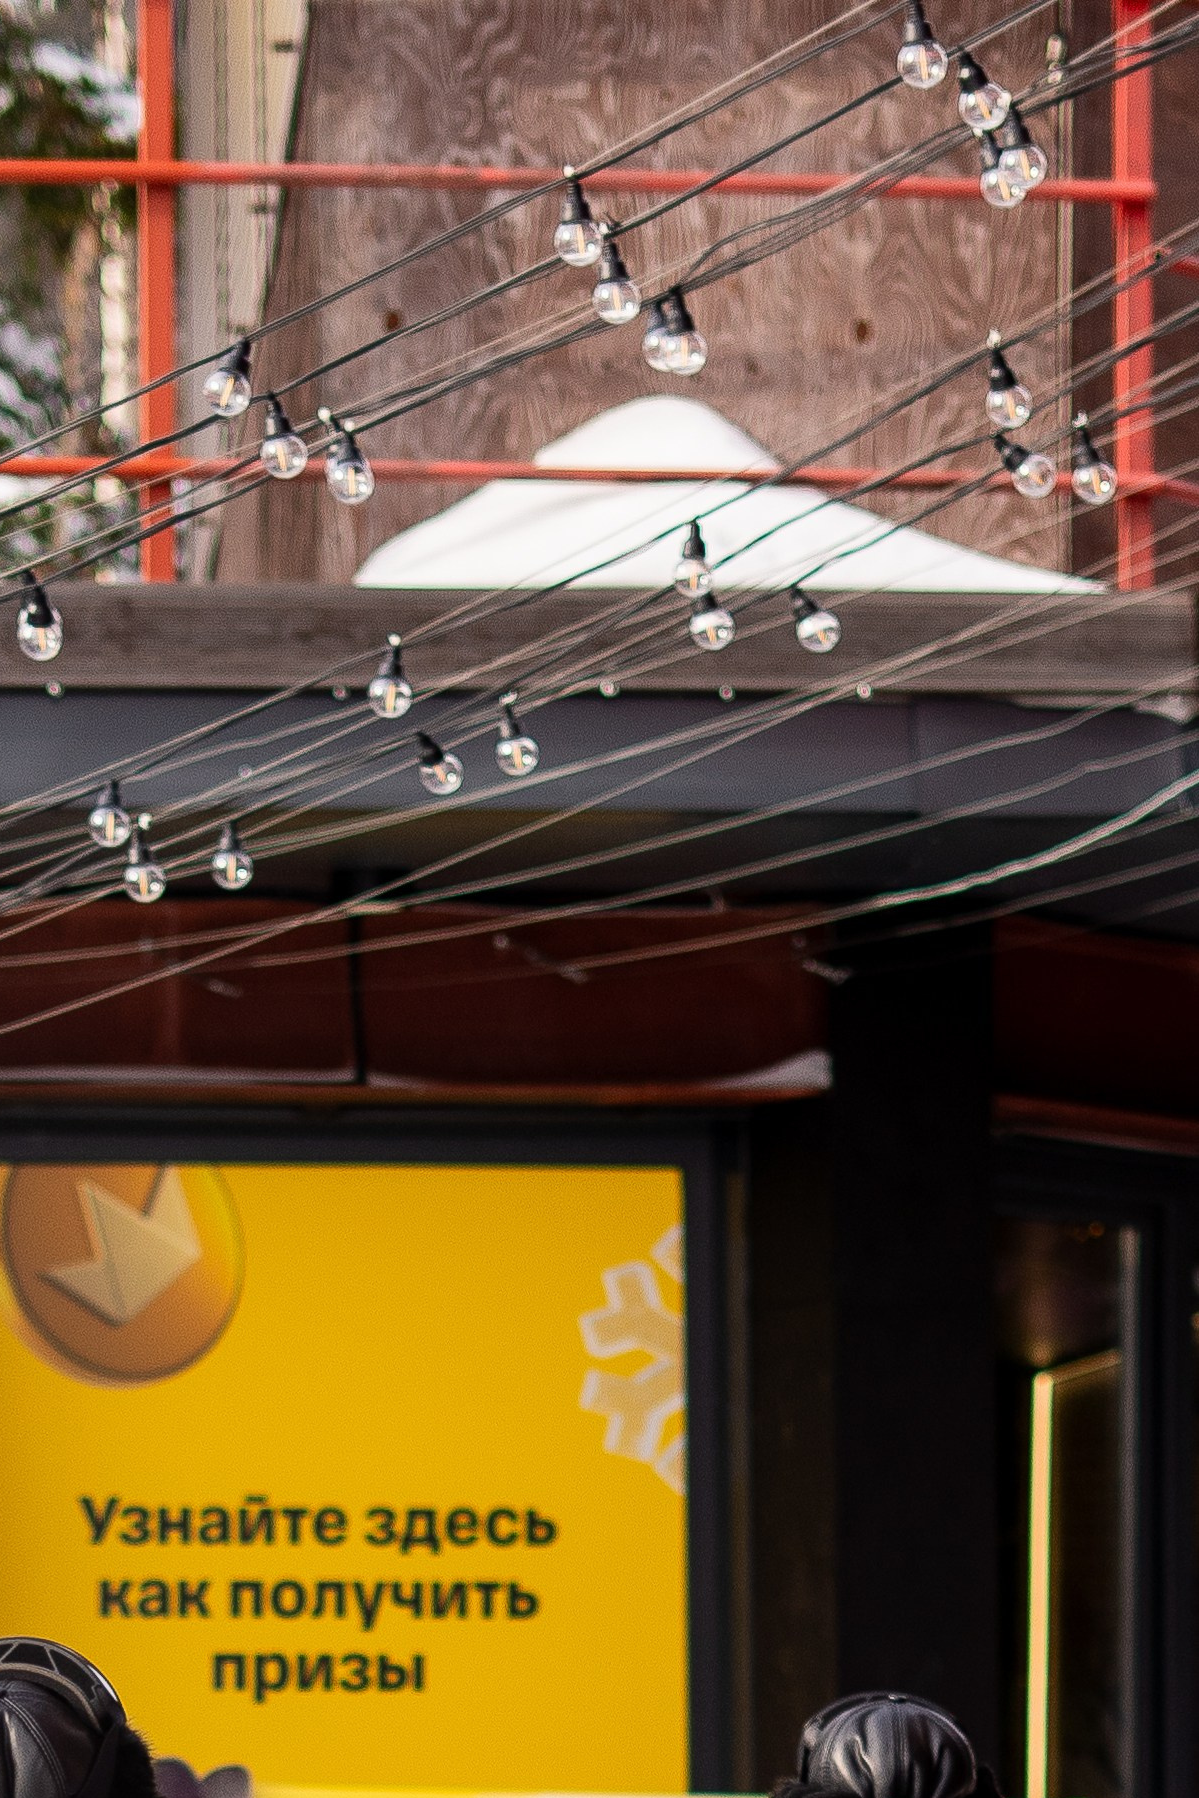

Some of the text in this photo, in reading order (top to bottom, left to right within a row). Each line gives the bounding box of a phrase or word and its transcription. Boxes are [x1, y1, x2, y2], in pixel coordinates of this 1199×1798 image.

[79, 1494, 559, 1556] Узнайте здесь
[98, 1578, 541, 1632] как получить
[211, 1652, 426, 1704] призы
